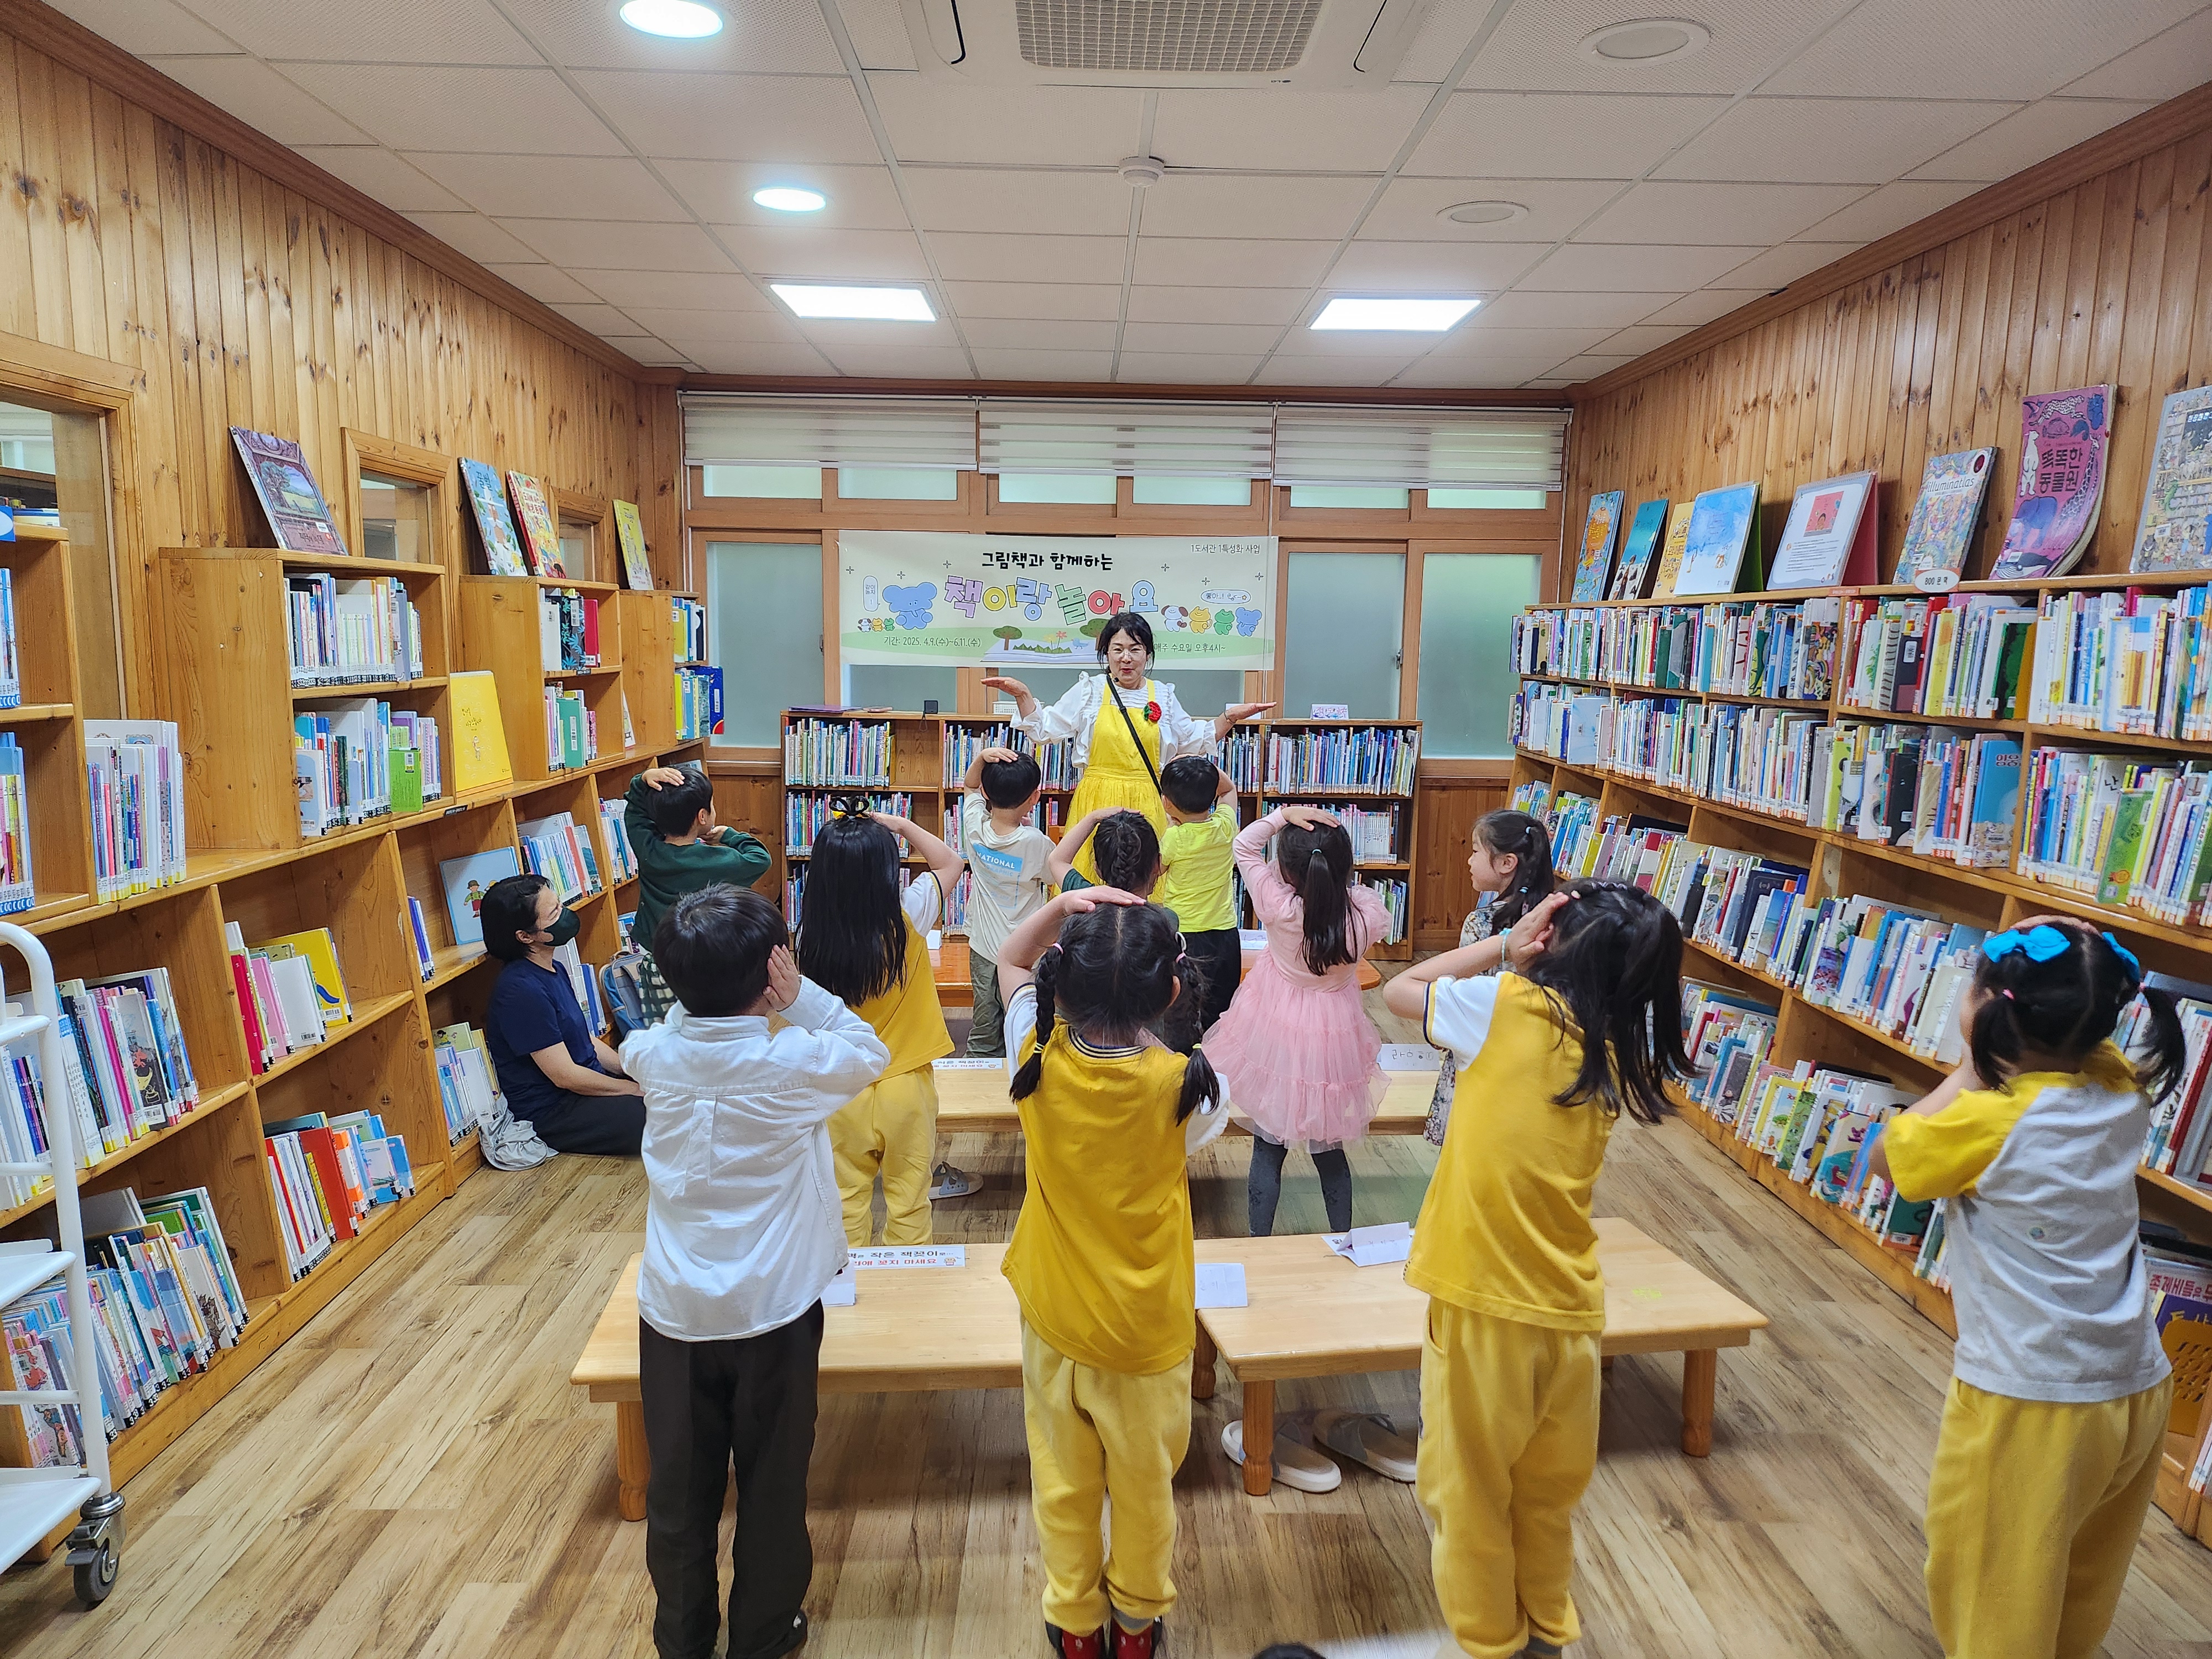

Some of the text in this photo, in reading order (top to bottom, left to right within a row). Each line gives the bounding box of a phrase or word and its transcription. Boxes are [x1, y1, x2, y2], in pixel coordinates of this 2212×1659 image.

[2042, 447, 2083, 469] 똑똑한
[1928, 476, 1975, 493] illuminatlas
[2039, 471, 2079, 493] 동물원
[1191, 544, 1260, 554] 1도서관 1특성화 사업
[982, 552, 1113, 571] 그림책과 함께하는
[1924, 577, 1935, 586] 800
[944, 575, 1052, 621] 책이랑
[884, 637, 901, 646] 기간:
[902, 637, 921, 646] 2025.
[1171, 644, 1192, 652] 수요일
[1194, 644, 1225, 652] 오후4시~
[977, 851, 1015, 869] NATIONAL
